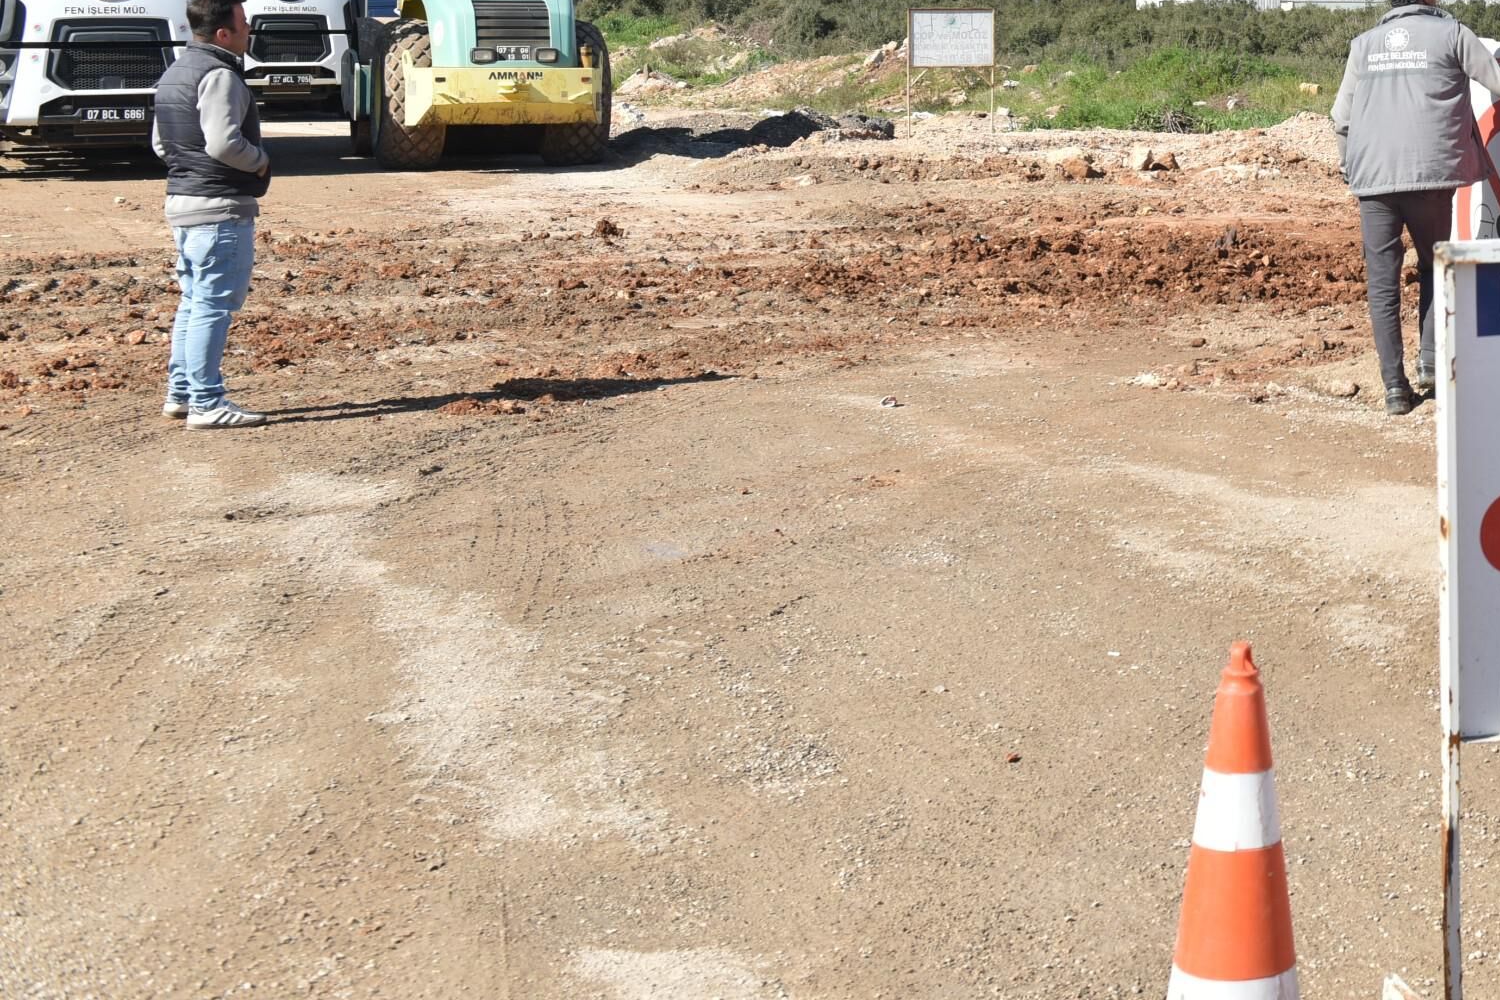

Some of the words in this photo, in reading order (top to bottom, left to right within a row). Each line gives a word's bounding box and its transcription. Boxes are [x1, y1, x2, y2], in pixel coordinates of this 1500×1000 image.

[64, 6, 85, 14] FEN
[88, 5, 121, 16] İŞLERİ
[1368, 53, 1389, 62] KEPEZ
[488, 72, 543, 80] AMMANN
[87, 110, 99, 120] 07
[102, 109, 120, 120] BCL
